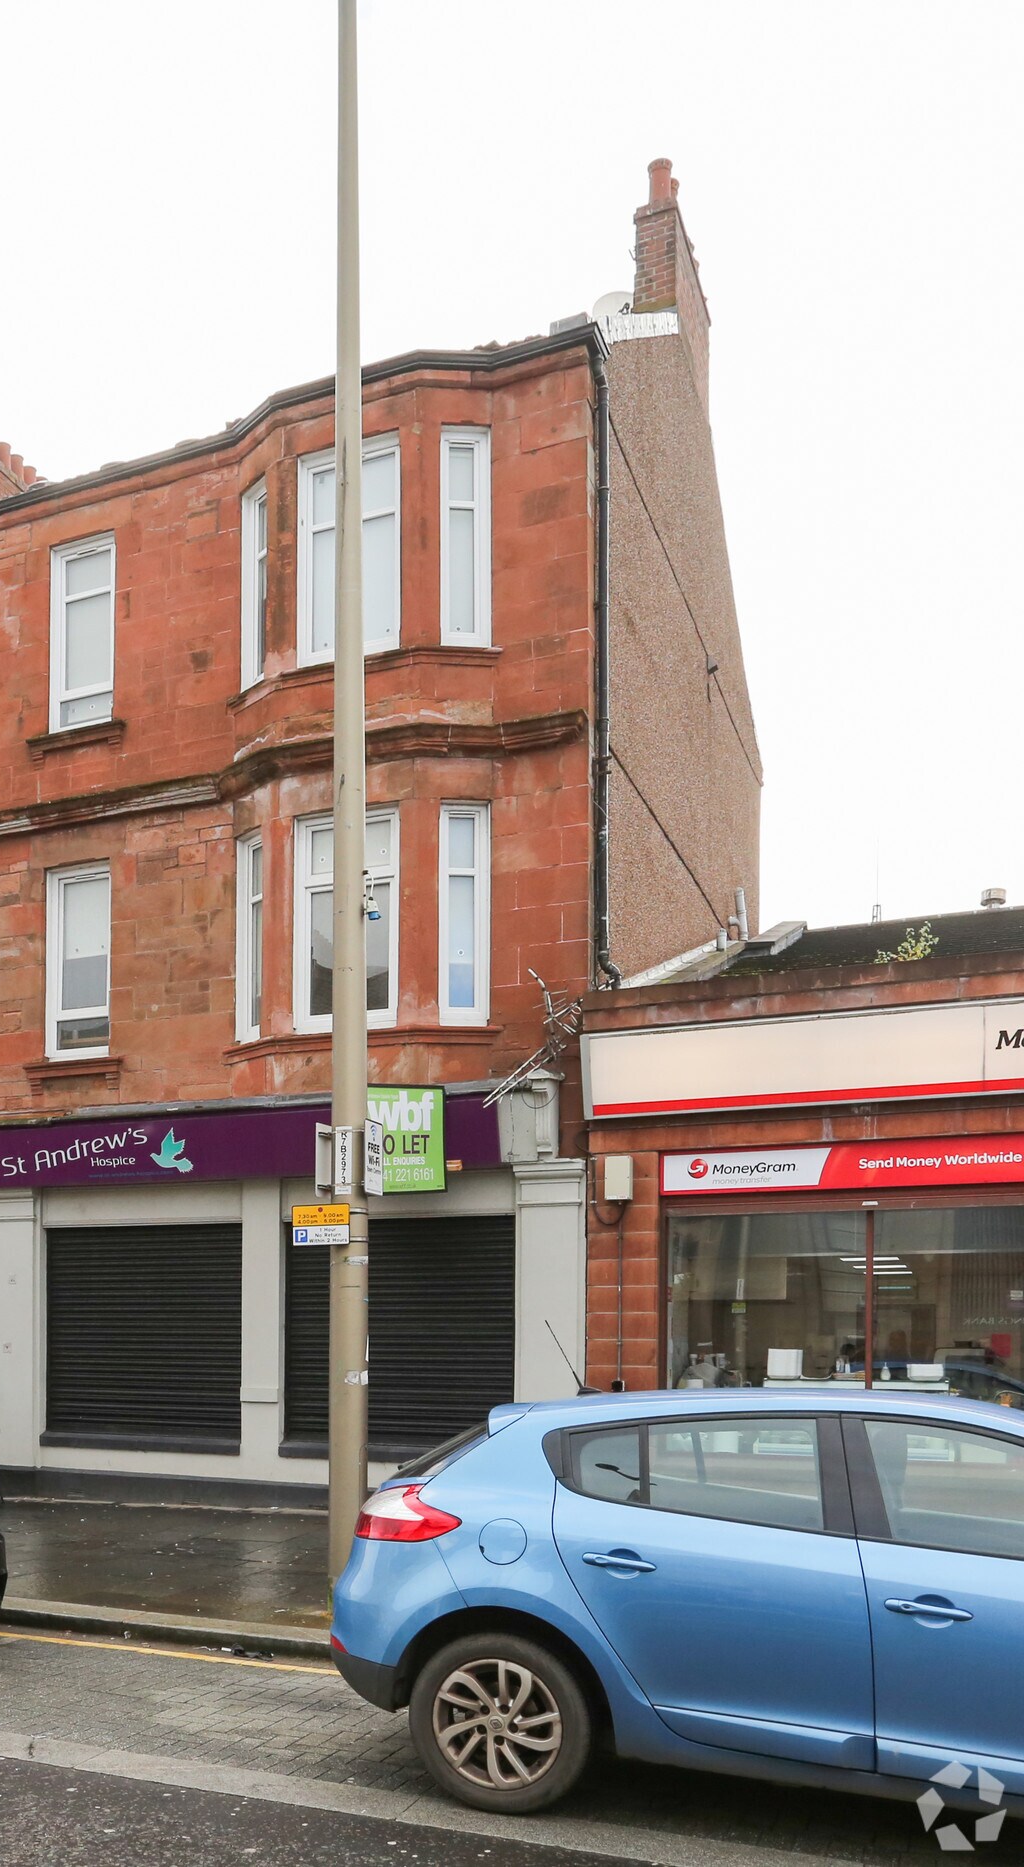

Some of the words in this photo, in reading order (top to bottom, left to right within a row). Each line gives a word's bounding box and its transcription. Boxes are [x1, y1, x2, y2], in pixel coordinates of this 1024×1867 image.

[995, 1029, 1024, 1050] M
[367, 1091, 434, 1131] wbf
[1, 1155, 27, 1177] St
[34, 1127, 148, 1172] Andrew's
[367, 1141, 380, 1155] FREE
[383, 1134, 395, 1155] O
[402, 1134, 430, 1154] LET
[90, 1155, 136, 1168] Hospice
[393, 1156, 425, 1166] ENQUIRIES
[858, 1157, 894, 1170] Send
[896, 1156, 942, 1168] Money
[944, 1151, 1023, 1166] Worldwide
[396, 1168, 411, 1182] 221
[413, 1167, 434, 1181] 6161
[712, 1161, 796, 1176] MoneyGram
[712, 1177, 739, 1185] money
[740, 1175, 772, 1184] transfer
